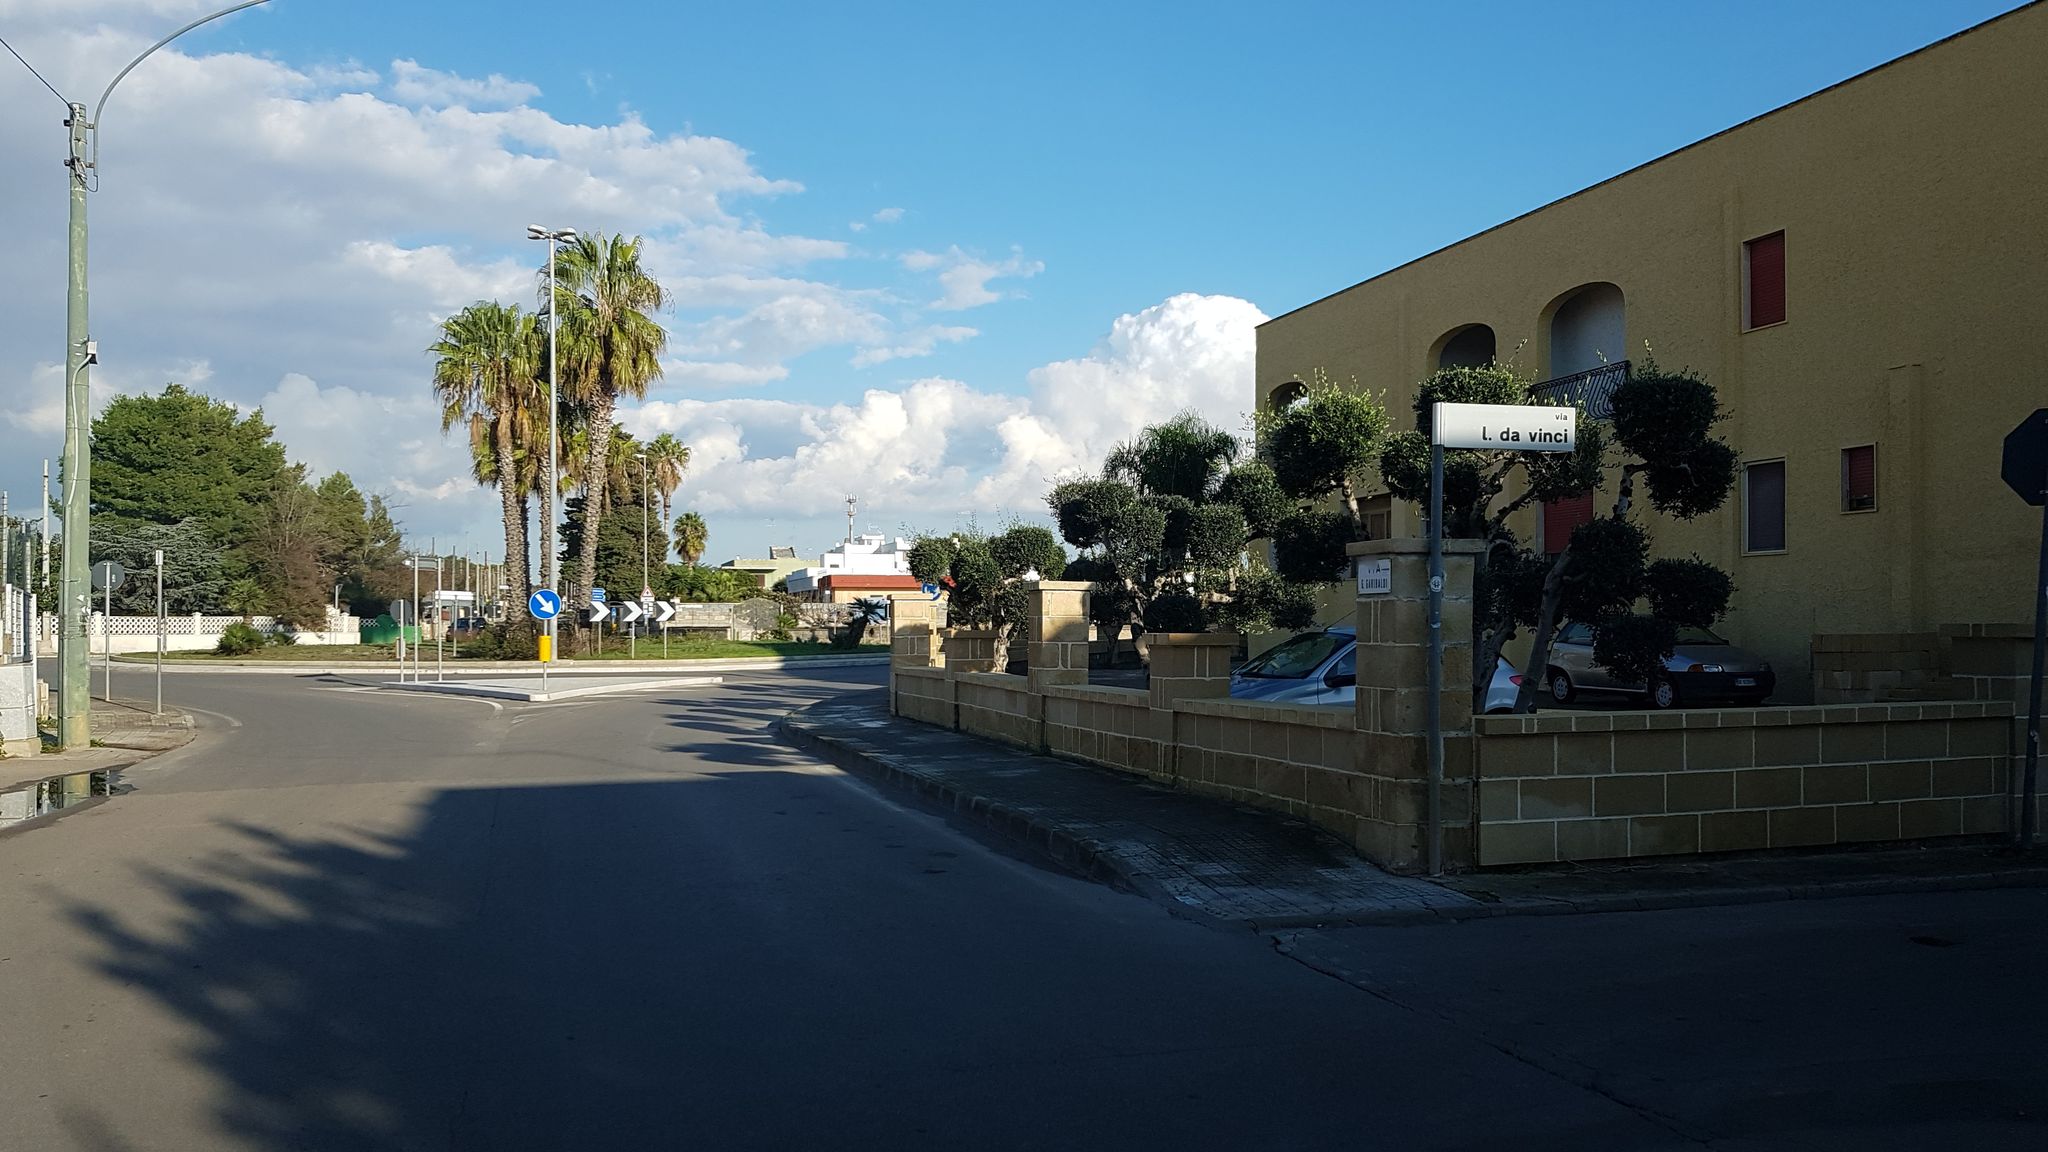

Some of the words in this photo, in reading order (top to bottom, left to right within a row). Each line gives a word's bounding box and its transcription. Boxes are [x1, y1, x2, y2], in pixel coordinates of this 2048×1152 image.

[1555, 413, 1568, 421] via
[1482, 426, 1492, 441] l.
[1499, 427, 1521, 442] da
[1528, 428, 1568, 443] vinci
